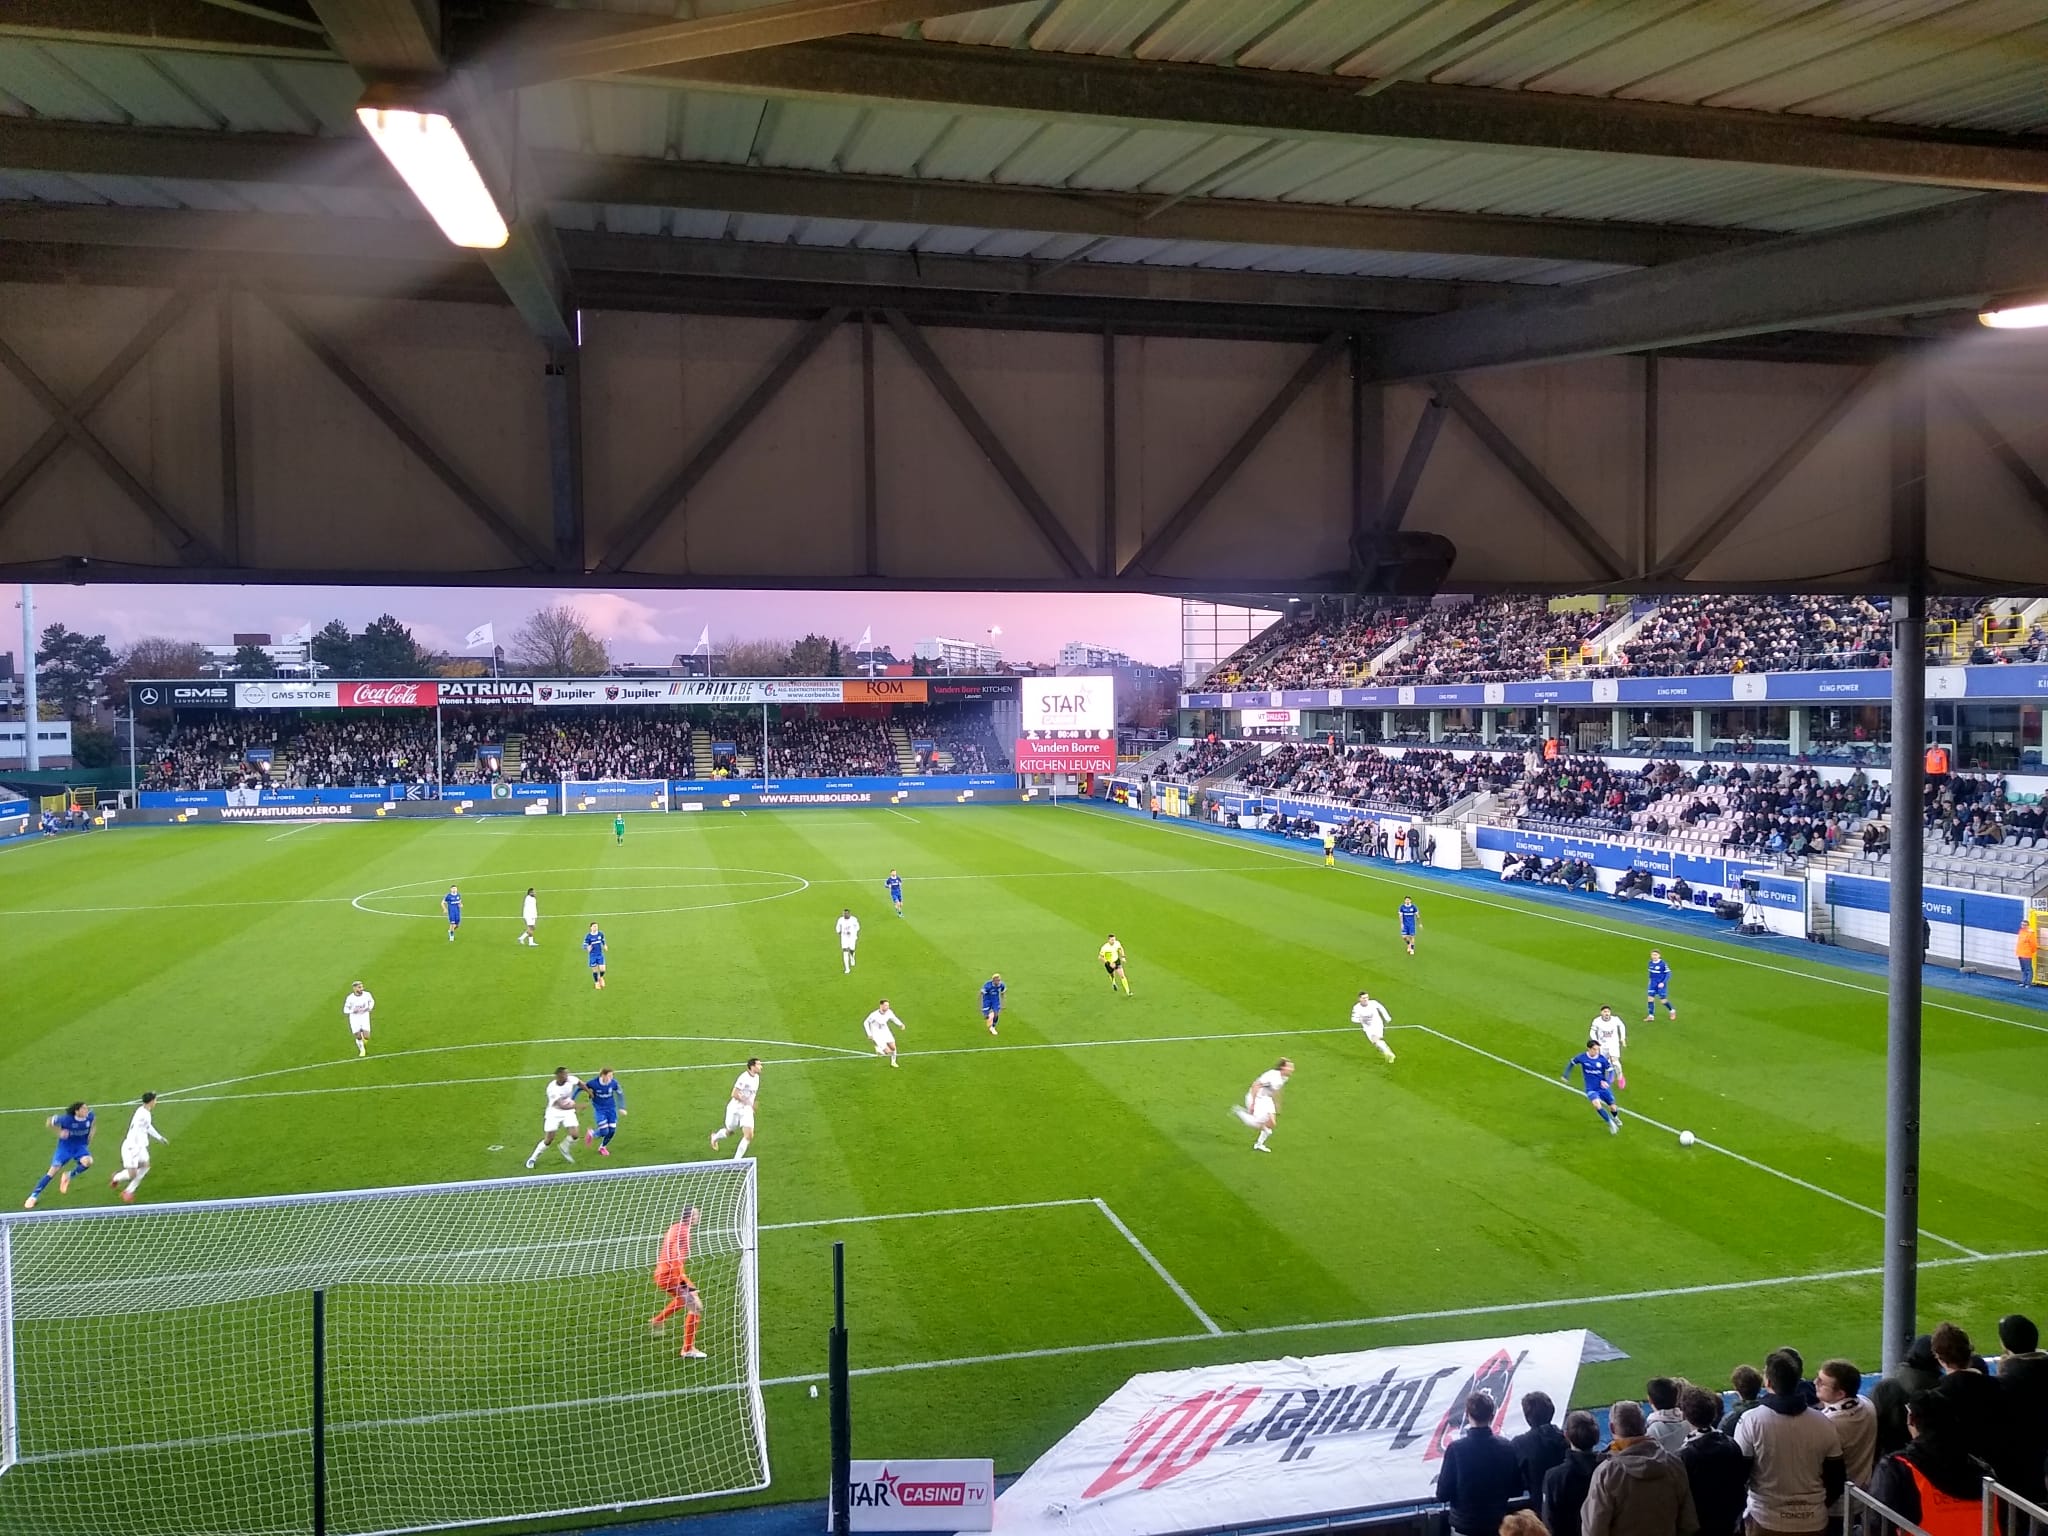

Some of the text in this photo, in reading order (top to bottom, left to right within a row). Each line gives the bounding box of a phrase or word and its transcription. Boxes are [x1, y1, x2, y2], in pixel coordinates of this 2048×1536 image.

[175, 688, 227, 697] GMS
[438, 683, 532, 696] PATRIMA
[621, 688, 662, 699] Jupiler
[867, 681, 904, 696] ROM
[961, 685, 981, 693] Borre
[1819, 684, 1835, 692] KING
[271, 691, 331, 699] GMS STORE
[354, 684, 421, 705] Coca-Cola
[555, 689, 596, 700] Jupiler
[475, 697, 500, 705] Slapen
[1041, 695, 1086, 713] STAR
[1045, 731, 1051, 739] 2
[1031, 742, 1100, 752] Vanden Borre
[1019, 759, 1111, 770] KITCHEN LEUVEN
[759, 793, 871, 803] WWW.FRITUURBOLERO.BE
[221, 806, 352, 818] WWW.FRITUURBOLERO.BE
[1528, 844, 1544, 852] POWER
[1563, 849, 1594, 860] KING POWER
[1633, 859, 1670, 871] KING POWER
[1770, 891, 1797, 903] POWER
[1223, 1365, 1460, 1462] Jupiler
[849, 1482, 984, 1506] TAR CASINO TV
